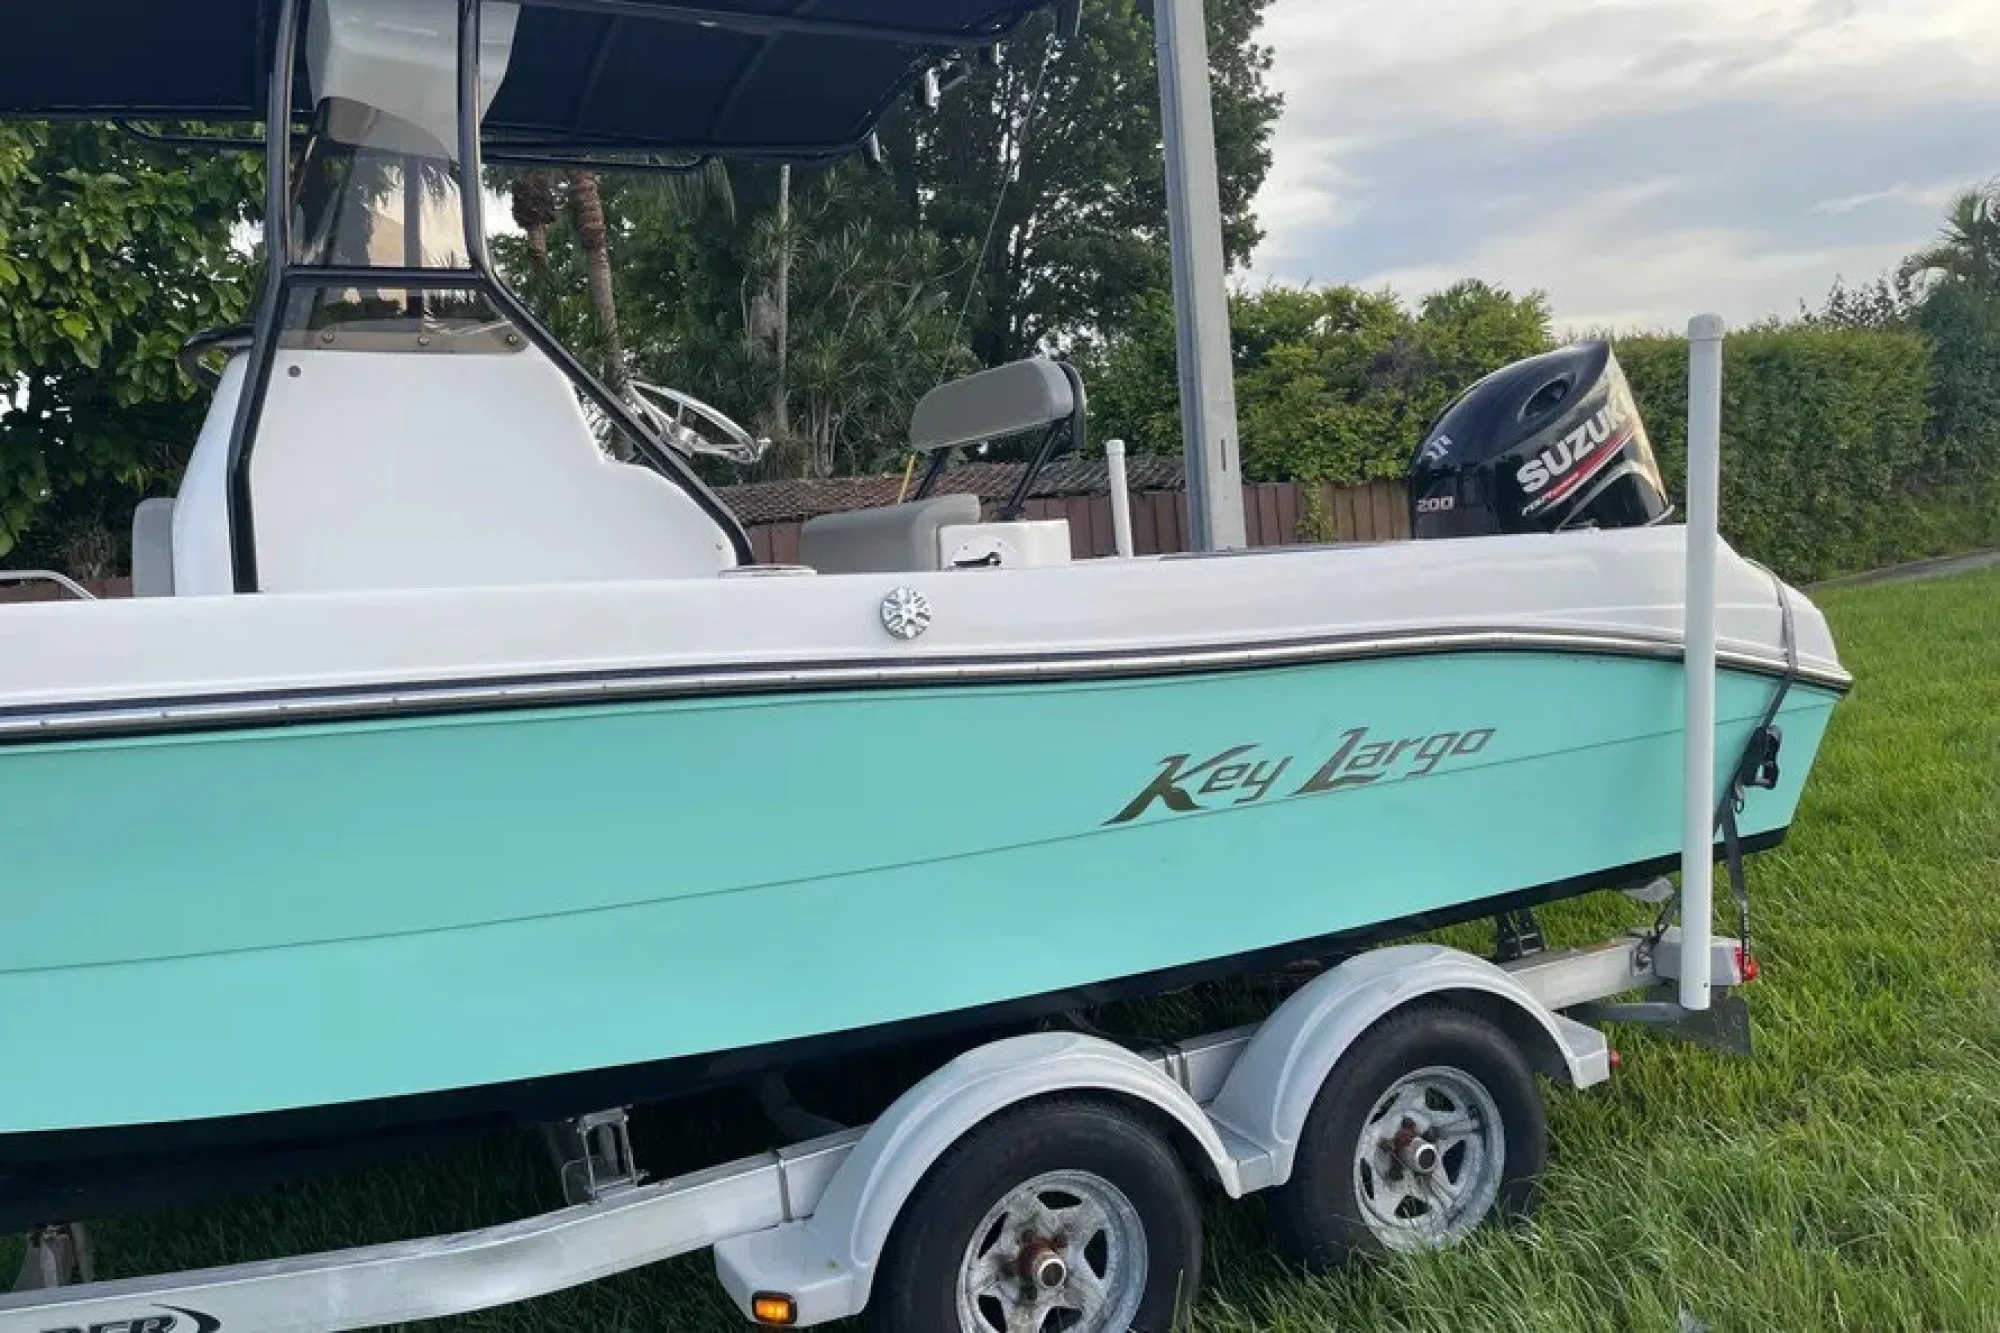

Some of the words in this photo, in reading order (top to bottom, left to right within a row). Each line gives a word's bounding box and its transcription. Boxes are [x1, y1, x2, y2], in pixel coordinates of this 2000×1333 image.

[1416, 495, 1455, 513] 200
[1101, 743, 1293, 826] Key
[1287, 726, 1497, 797] Largo
